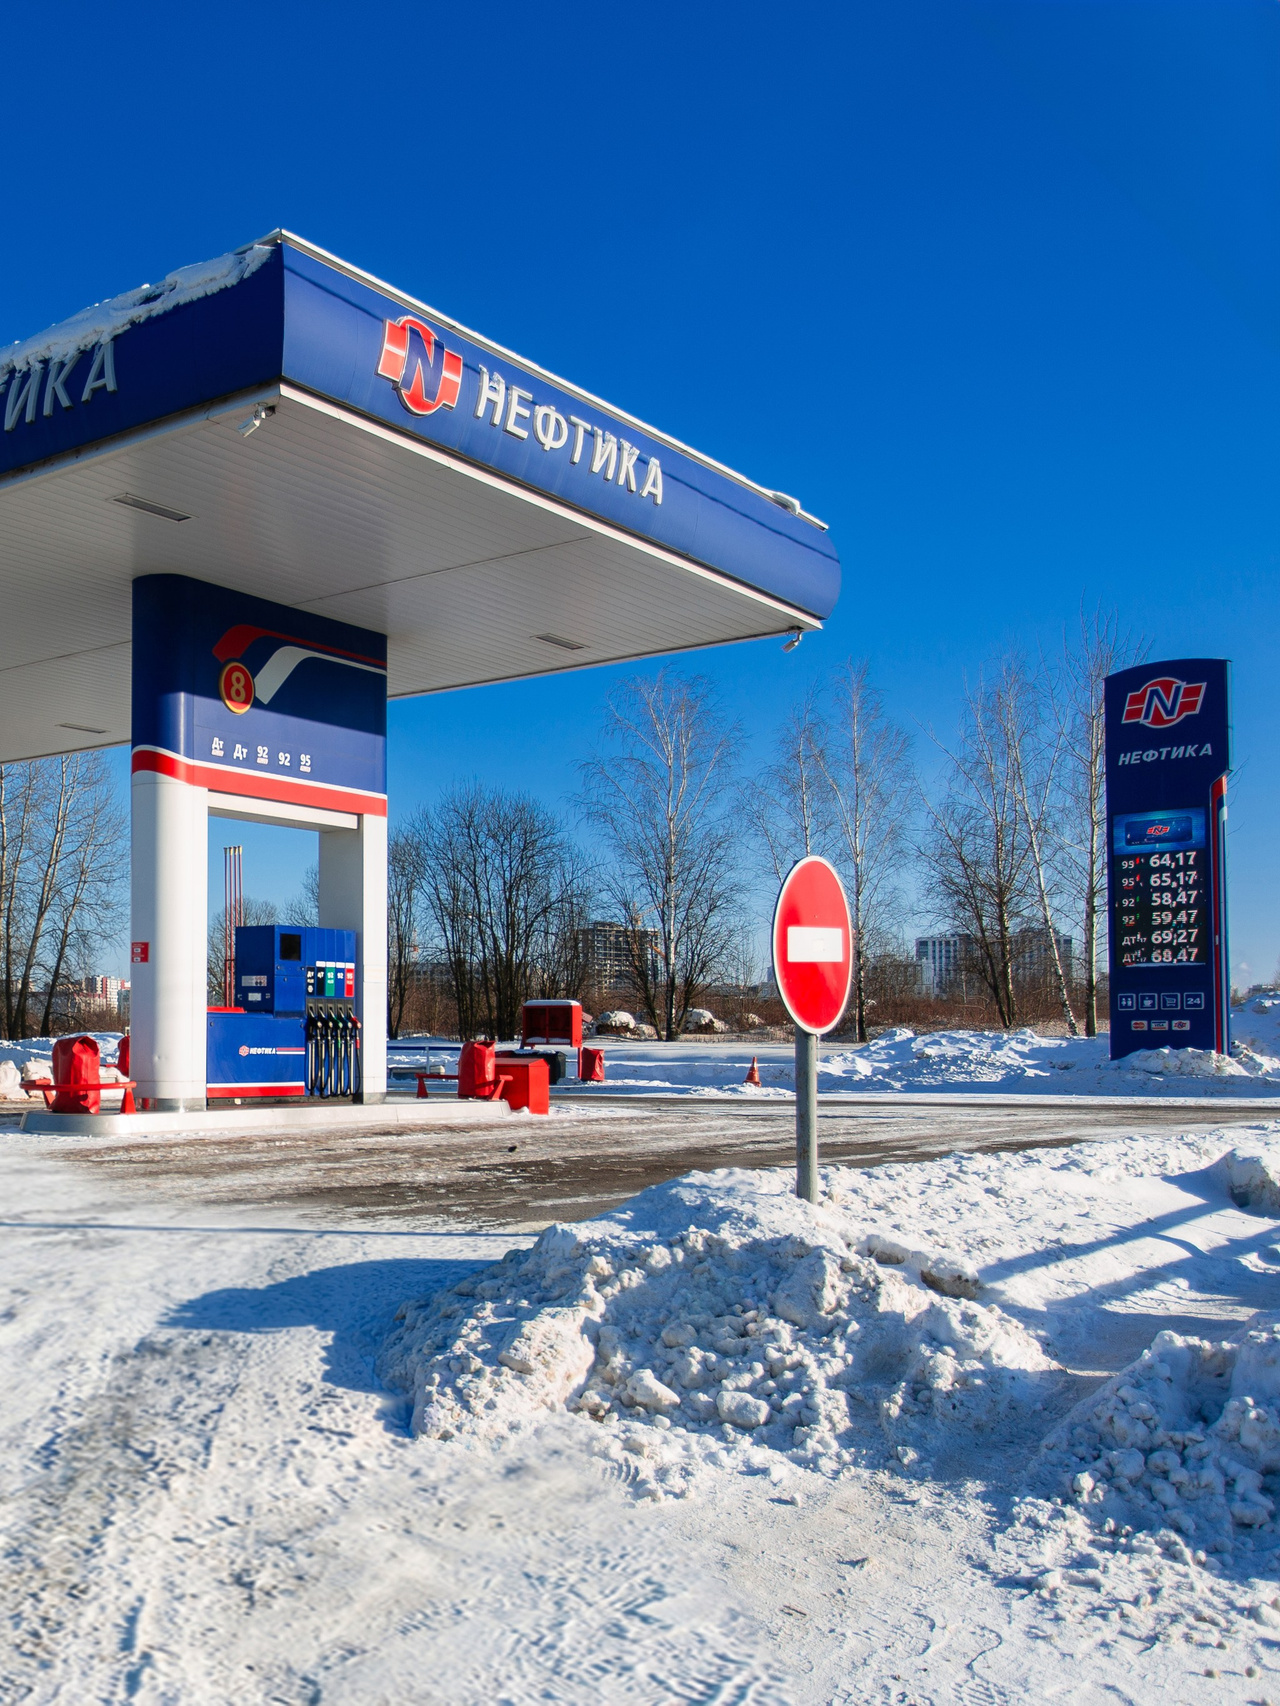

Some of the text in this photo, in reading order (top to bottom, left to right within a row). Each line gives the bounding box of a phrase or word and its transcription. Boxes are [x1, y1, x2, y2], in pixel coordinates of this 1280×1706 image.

[473, 364, 663, 506] НЕФТИКА
[230, 671, 246, 703] 8
[233, 744, 248, 760] Дт
[257, 745, 268, 758] 92
[278, 752, 291, 766] 92
[300, 753, 311, 766] 95
[1118, 743, 1213, 766] НЕФТИКА
[1149, 851, 1197, 869] 64,17
[1121, 871, 1197, 888] 95 65,17
[1122, 890, 1198, 908] 92 58,47
[1151, 909, 1198, 925] 59,47
[1151, 928, 1198, 946] 69,27
[1151, 947, 1198, 964] 68,47
